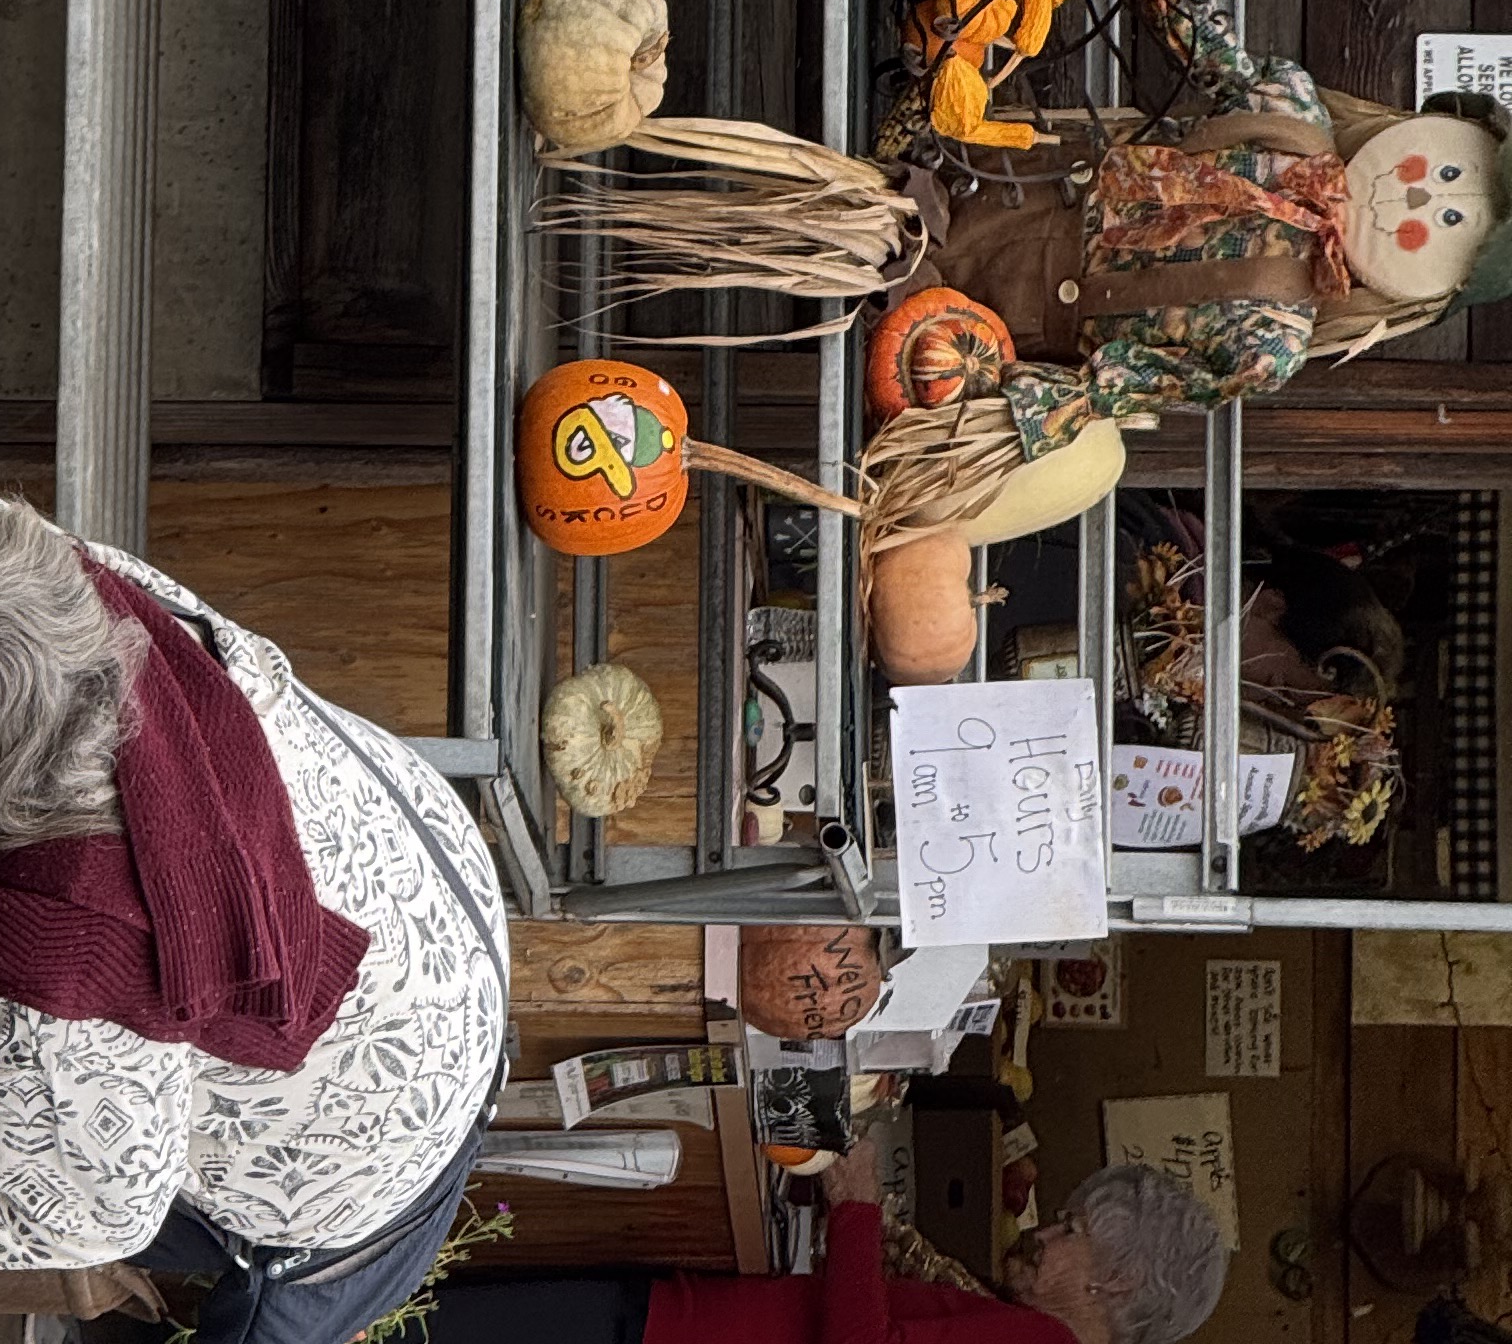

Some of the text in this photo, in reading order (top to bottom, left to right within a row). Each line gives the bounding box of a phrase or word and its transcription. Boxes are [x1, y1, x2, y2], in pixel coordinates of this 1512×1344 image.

[1456, 44, 1475, 94] ALLOW
[1477, 63, 1496, 94] SER
[535, 492, 668, 524] DUCKS
[908, 717, 999, 921] 9 am to 5 pm
[1008, 733, 1068, 876] Hours
